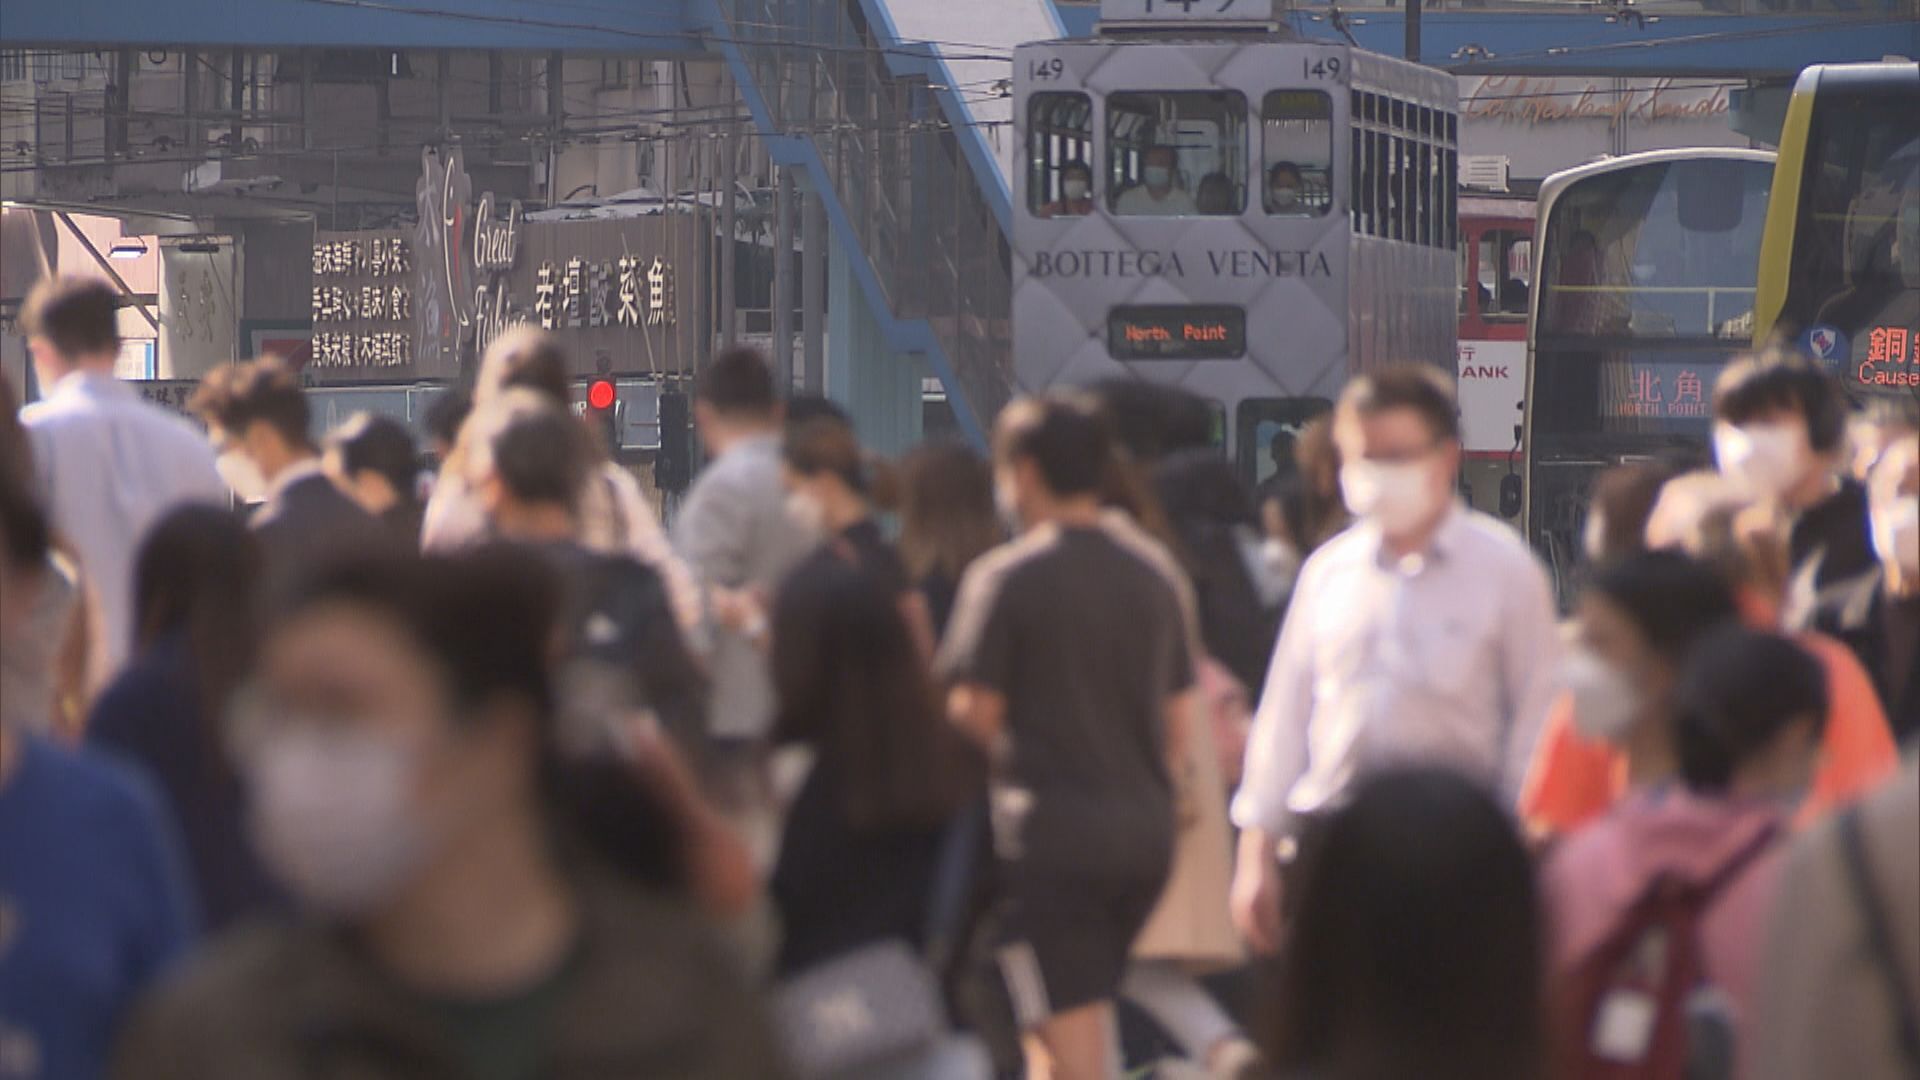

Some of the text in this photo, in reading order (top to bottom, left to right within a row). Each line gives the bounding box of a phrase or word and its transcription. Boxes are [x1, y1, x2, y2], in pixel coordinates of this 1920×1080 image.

[1030, 59, 1063, 82] 149
[1304, 57, 1341, 80] 149
[474, 198, 515, 268] Great
[1035, 250, 1331, 278] BOTTEGA VENETA
[1125, 323, 1227, 341] North Point
[1867, 326, 1919, 364] 銅
[1458, 365, 1509, 378] ANK
[1858, 360, 1919, 386] Cause
[1628, 368, 1702, 402] 北角
[1617, 402, 1708, 416] NORTH POINT
